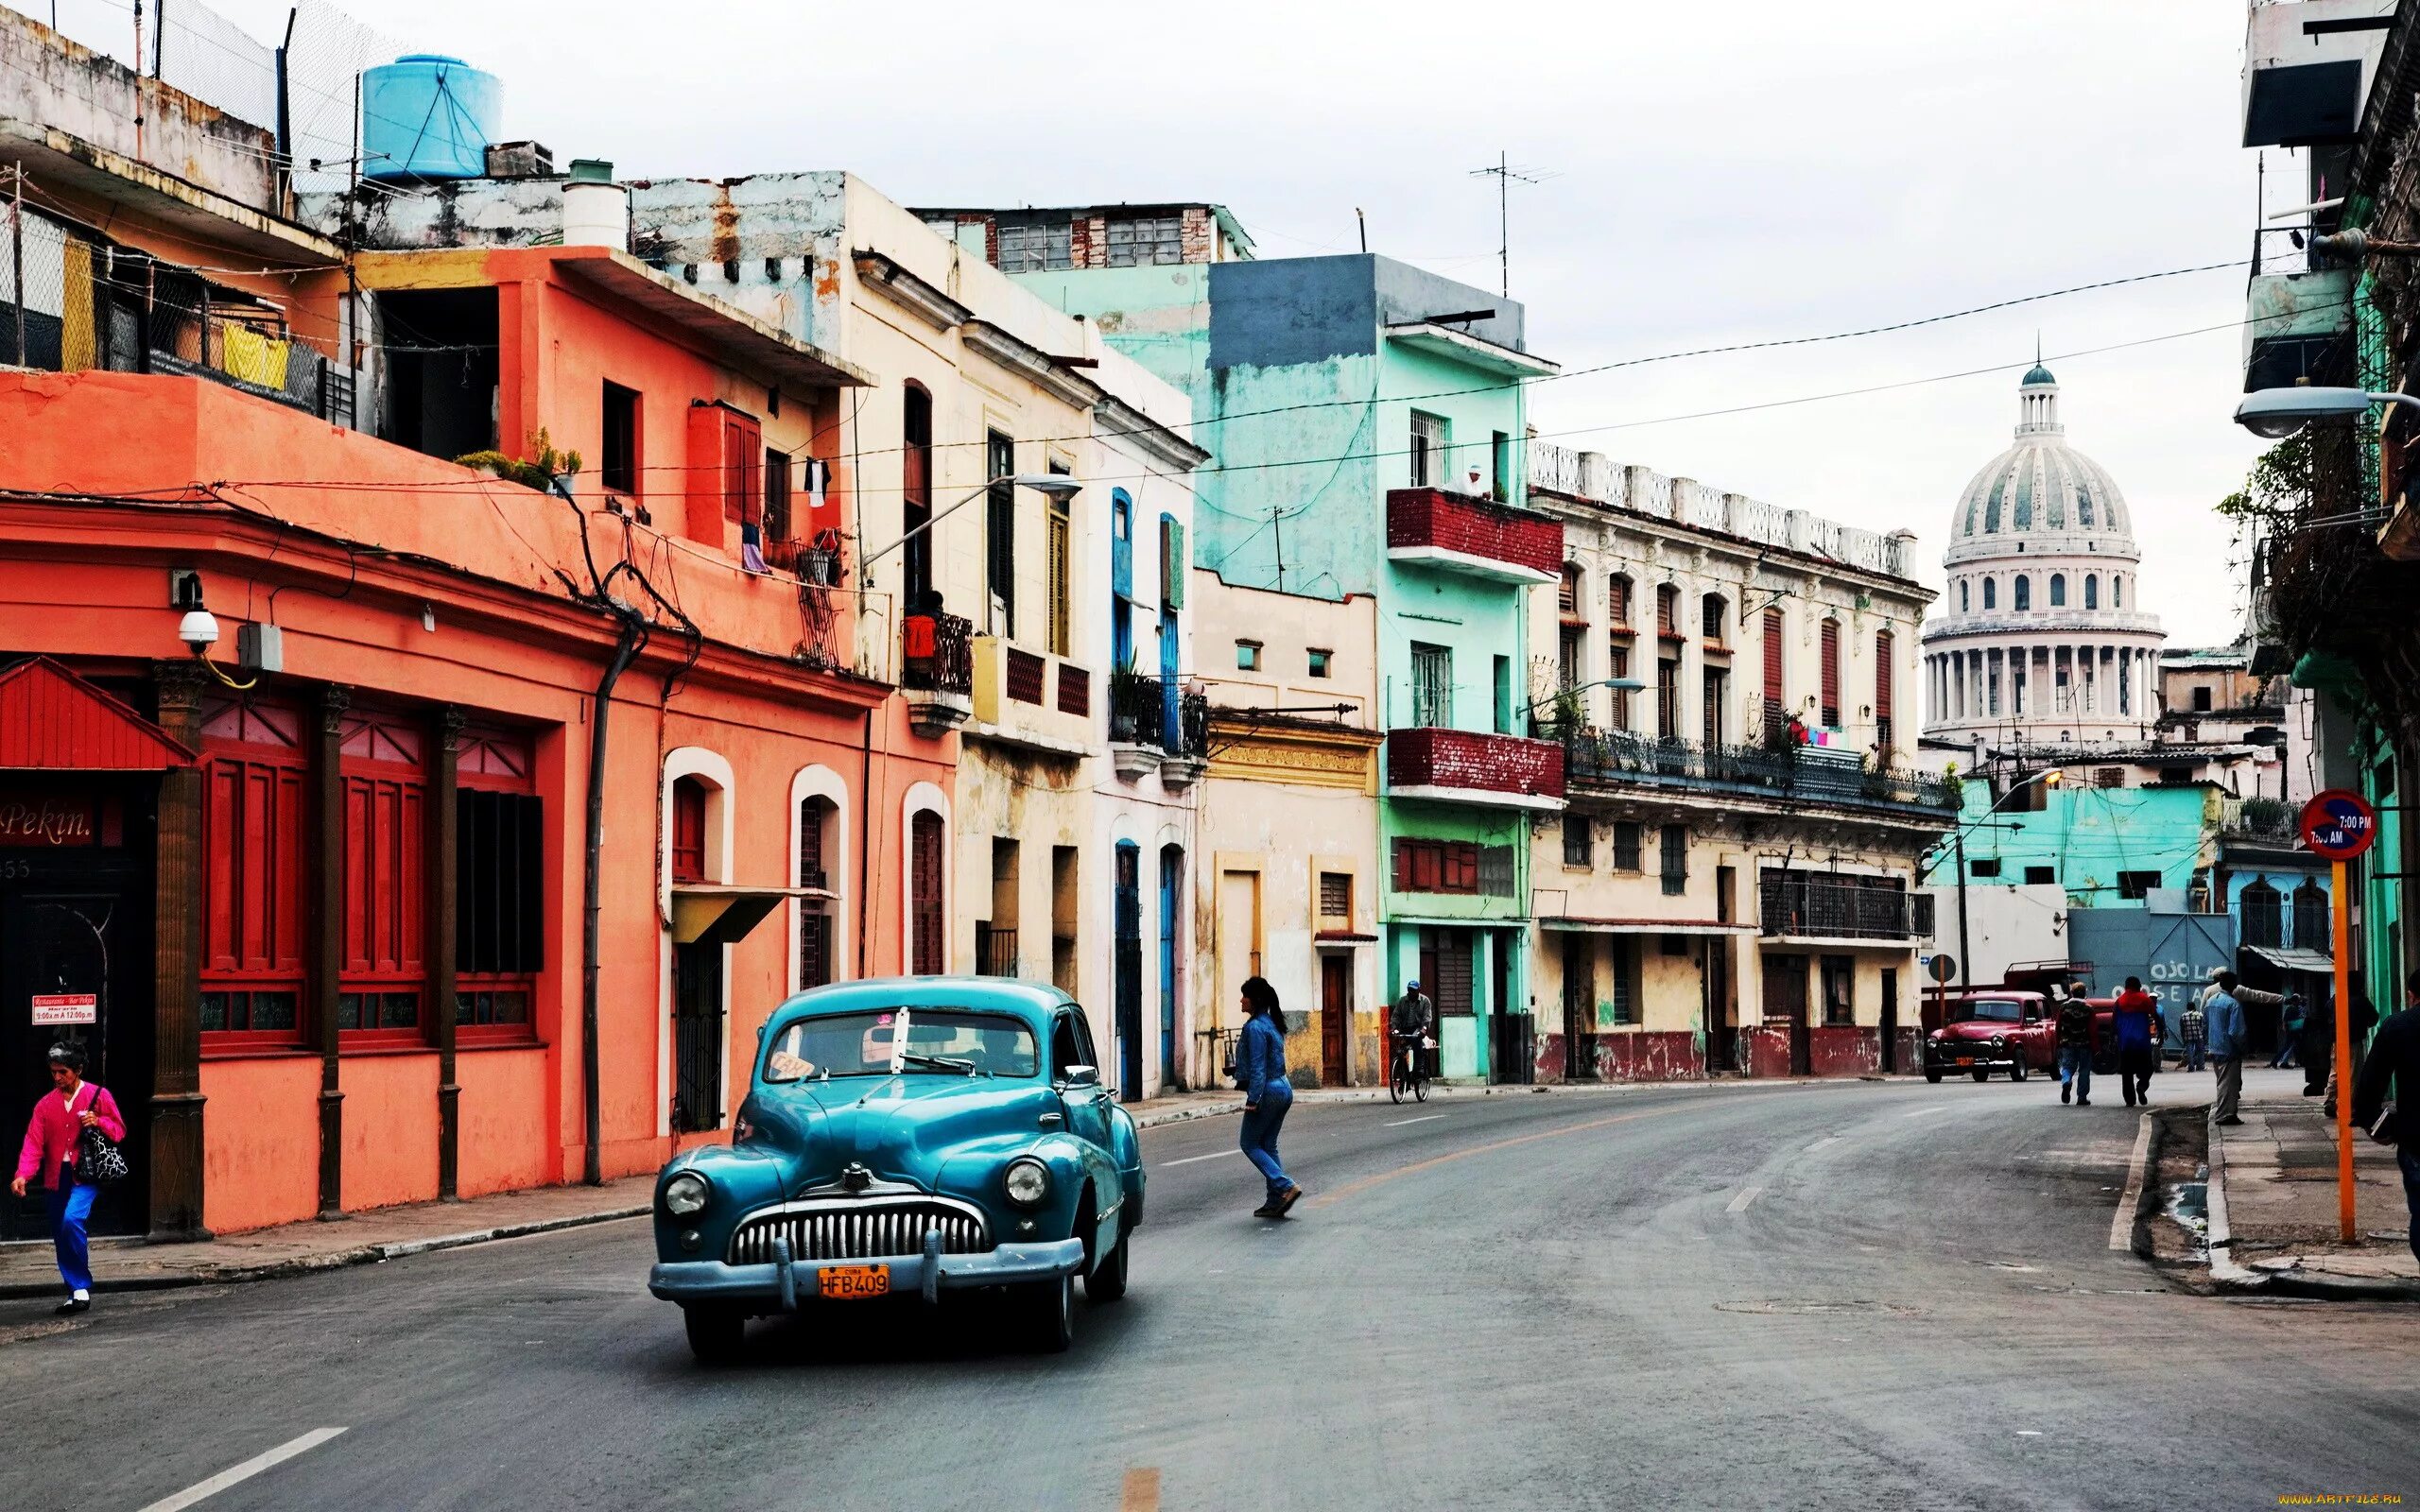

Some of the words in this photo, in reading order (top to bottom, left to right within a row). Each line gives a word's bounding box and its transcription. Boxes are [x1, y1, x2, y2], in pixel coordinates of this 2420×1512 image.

[2340, 816, 2357, 829] 7:00
[2359, 816, 2372, 829] PM
[2329, 831, 2343, 844] AM
[820, 1274, 888, 1294] HFB409
